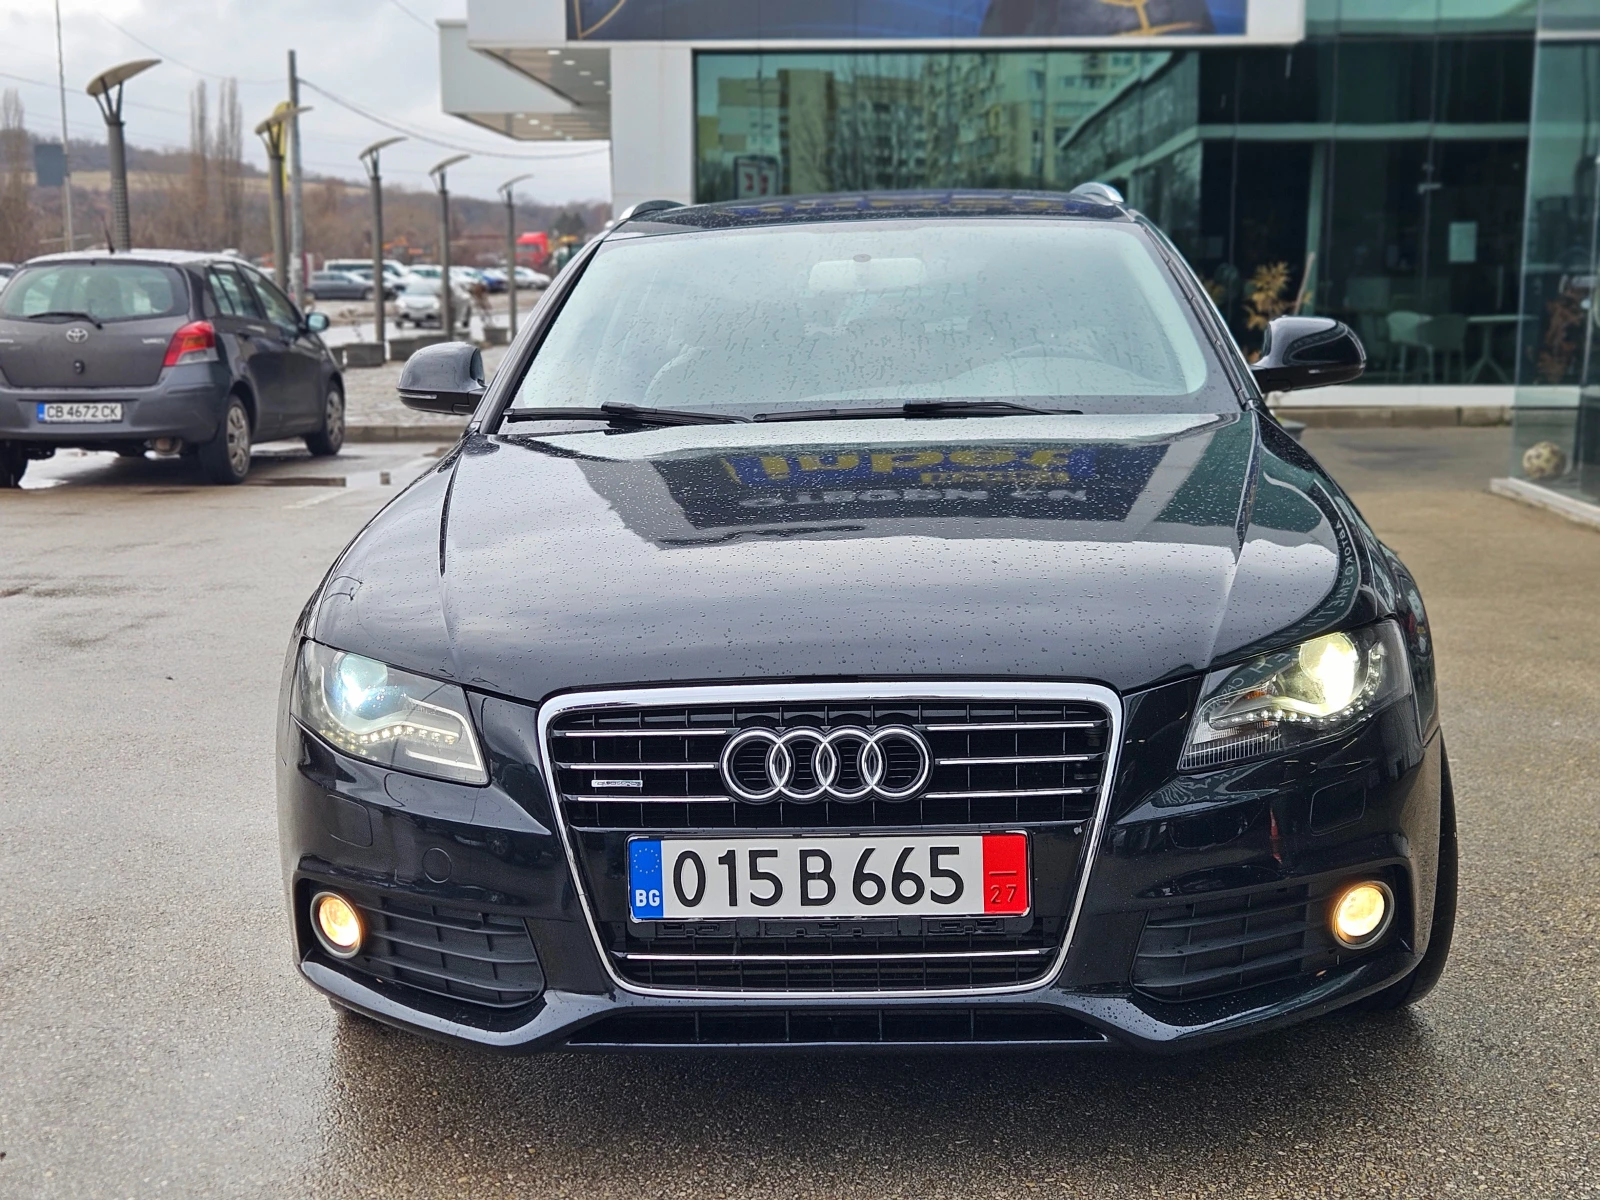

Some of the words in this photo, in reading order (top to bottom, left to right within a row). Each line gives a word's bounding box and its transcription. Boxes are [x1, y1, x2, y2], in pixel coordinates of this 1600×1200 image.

[46, 405, 64, 419] CB
[66, 405, 99, 419] 4672
[101, 405, 118, 418] CK
[635, 889, 660, 908] BG
[989, 885, 1017, 904] 27
